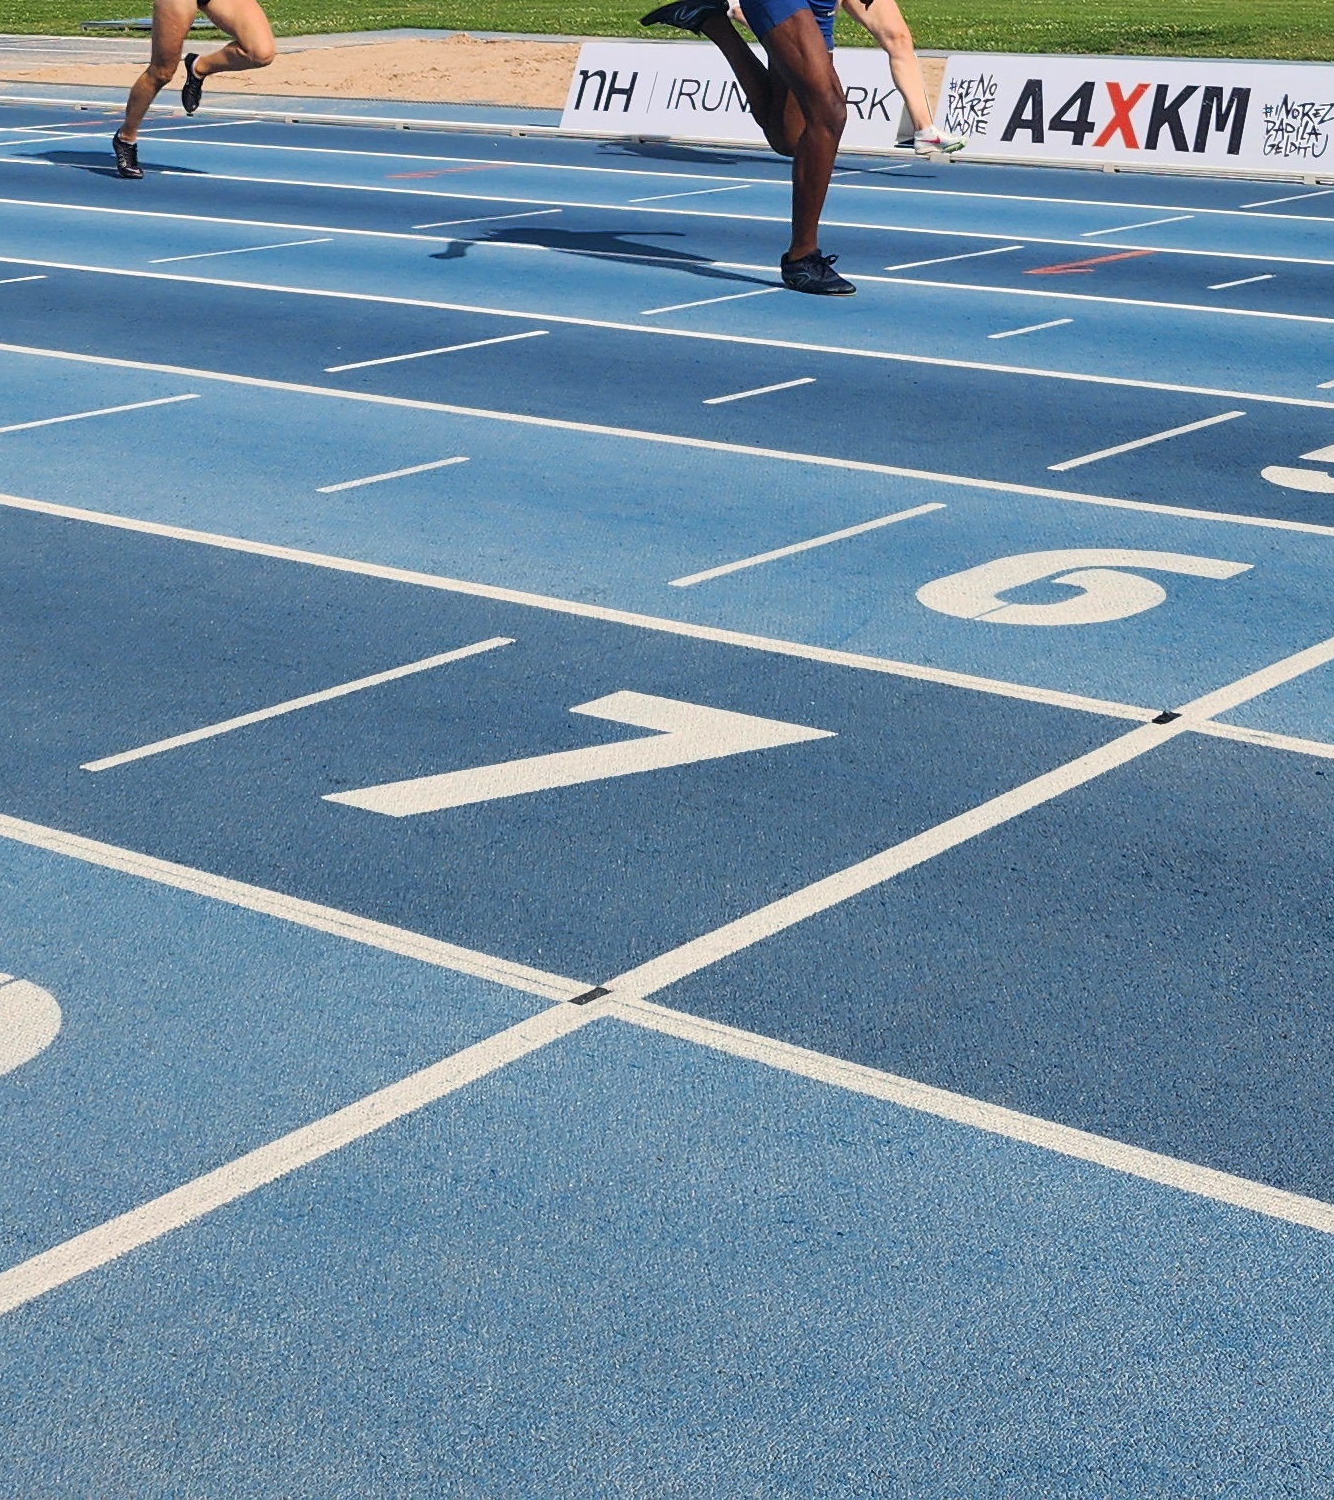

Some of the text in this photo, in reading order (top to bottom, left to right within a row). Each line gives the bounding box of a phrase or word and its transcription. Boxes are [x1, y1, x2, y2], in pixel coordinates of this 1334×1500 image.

[944, 113, 988, 138] NADIE
[1000, 79, 1252, 155] A4XKM
[914, 547, 1255, 626] 6
[320, 689, 840, 817] 7
